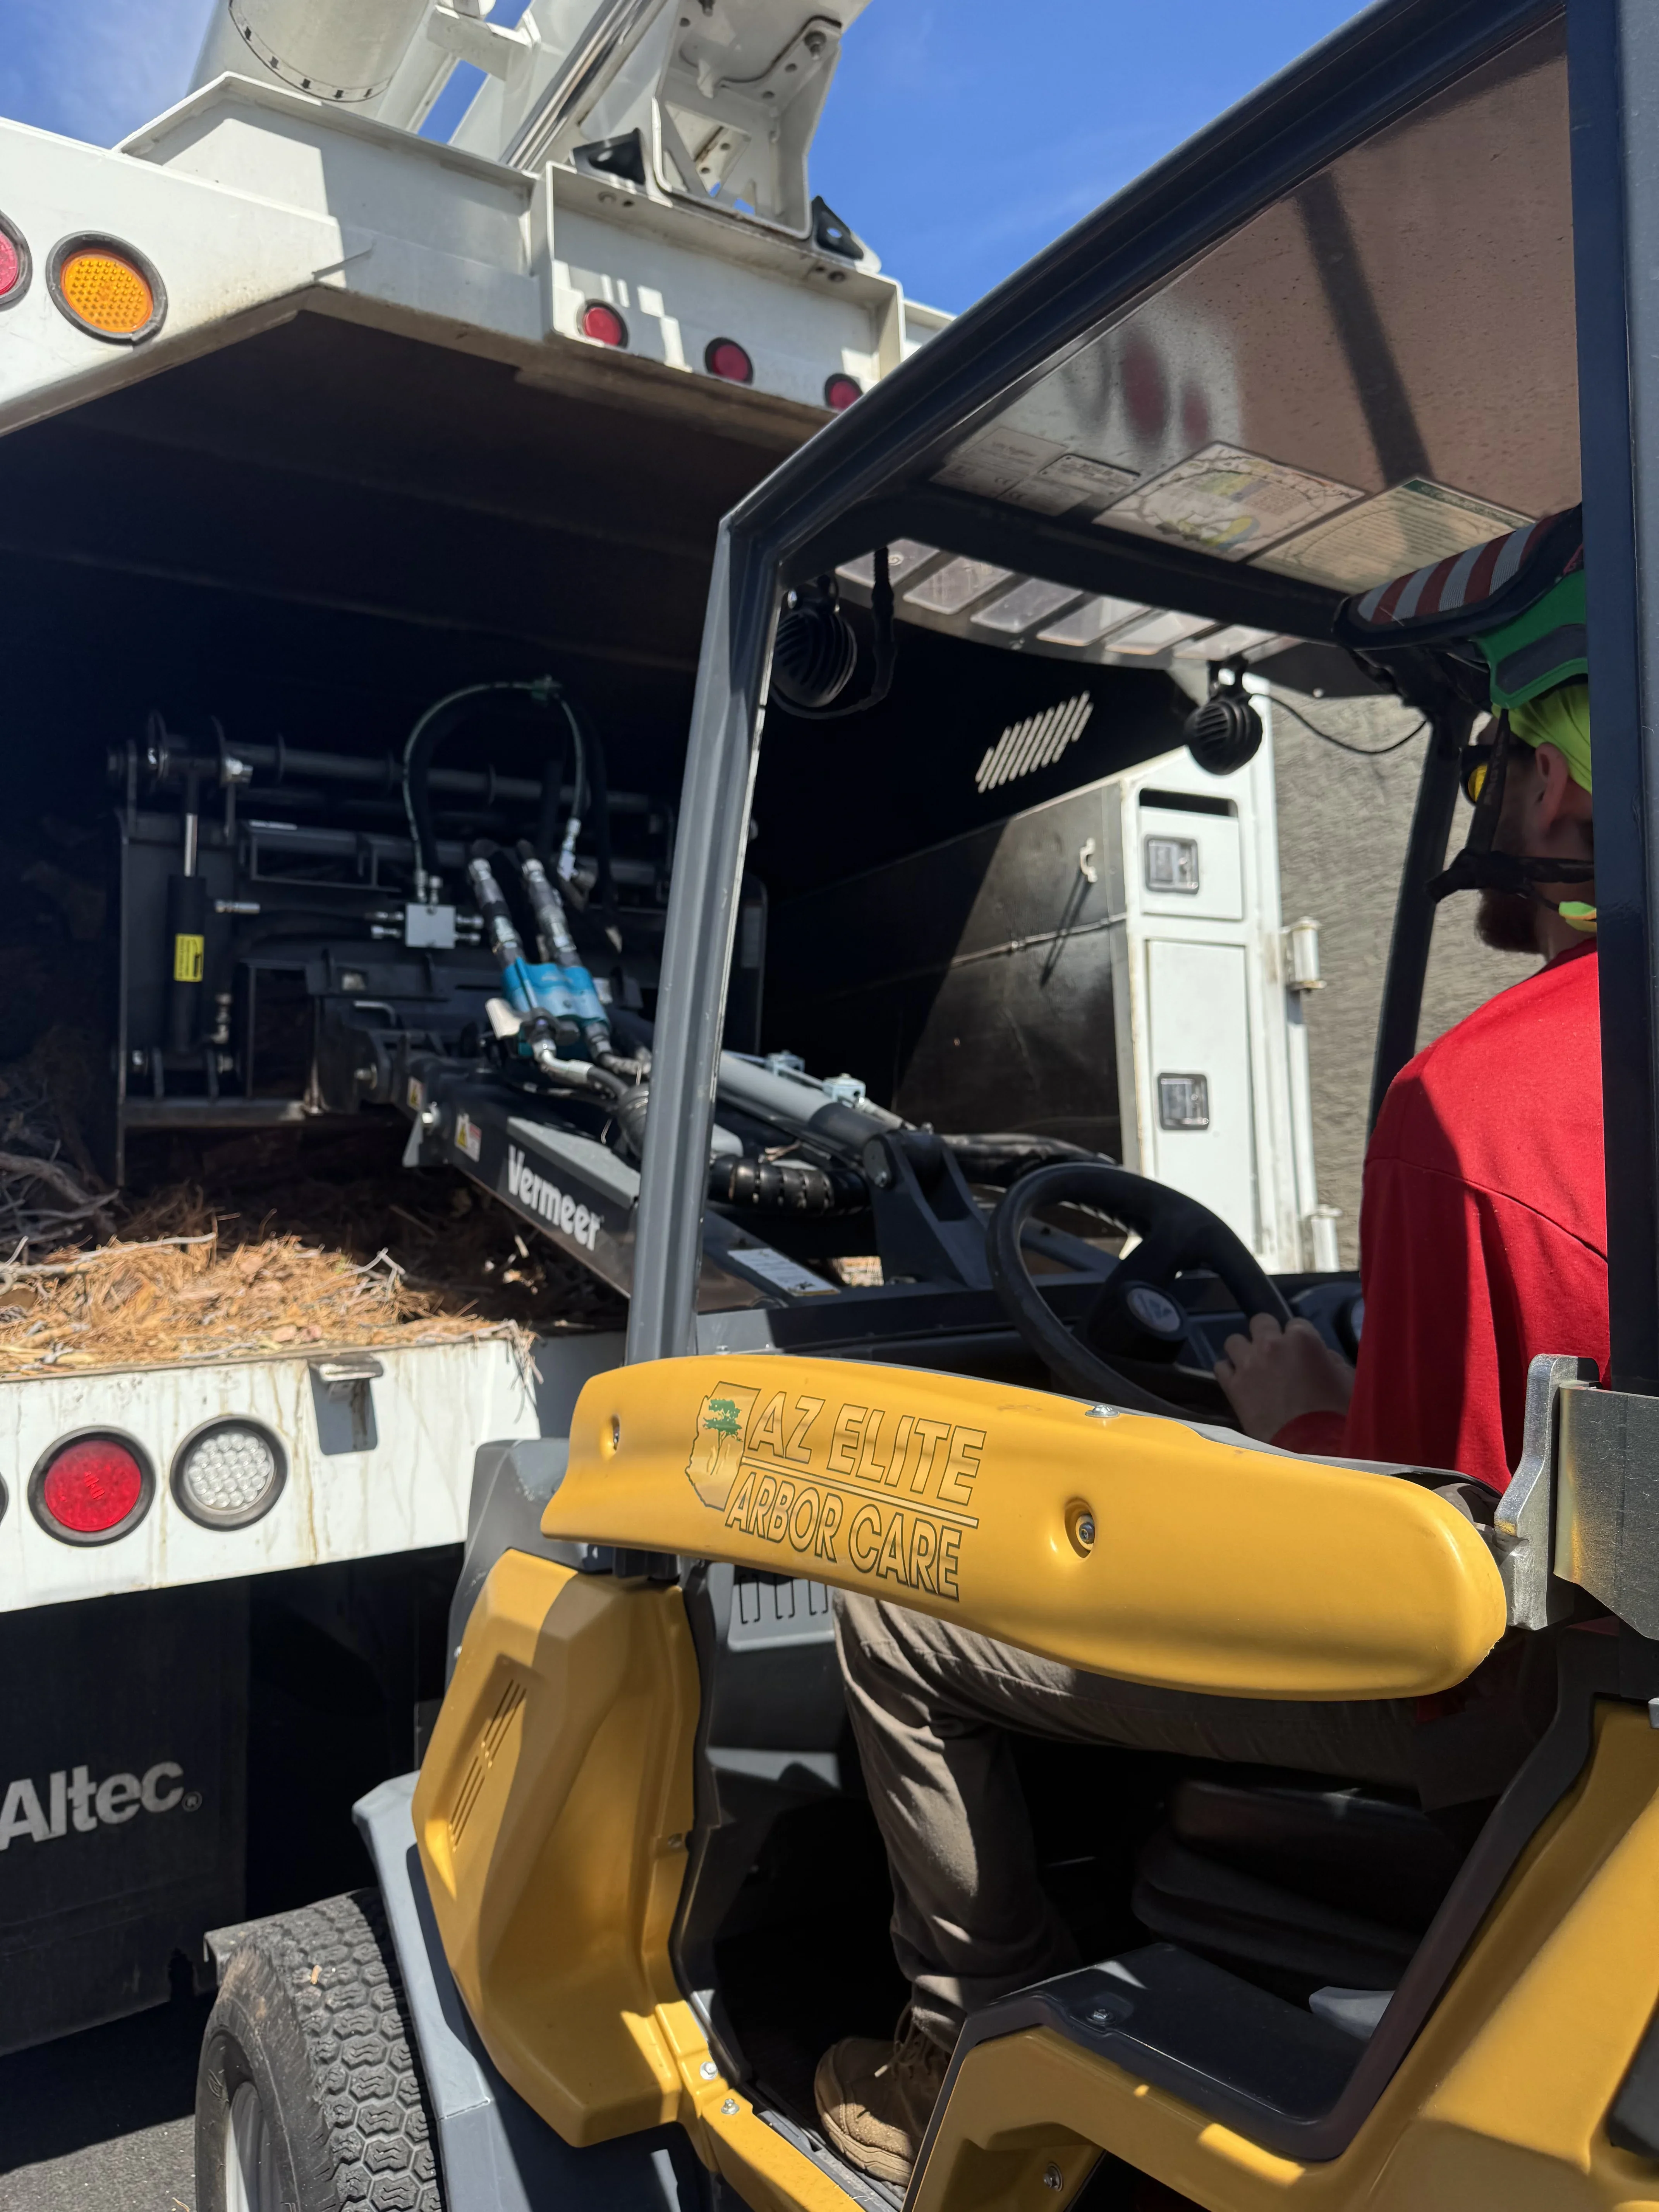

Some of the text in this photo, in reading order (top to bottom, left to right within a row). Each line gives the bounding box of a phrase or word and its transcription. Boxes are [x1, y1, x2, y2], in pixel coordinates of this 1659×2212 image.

[508, 1144, 601, 1251] Vermeer
[747, 1391, 987, 1506] AZ ELITE
[725, 1472, 962, 1601] ARBOR CARE
